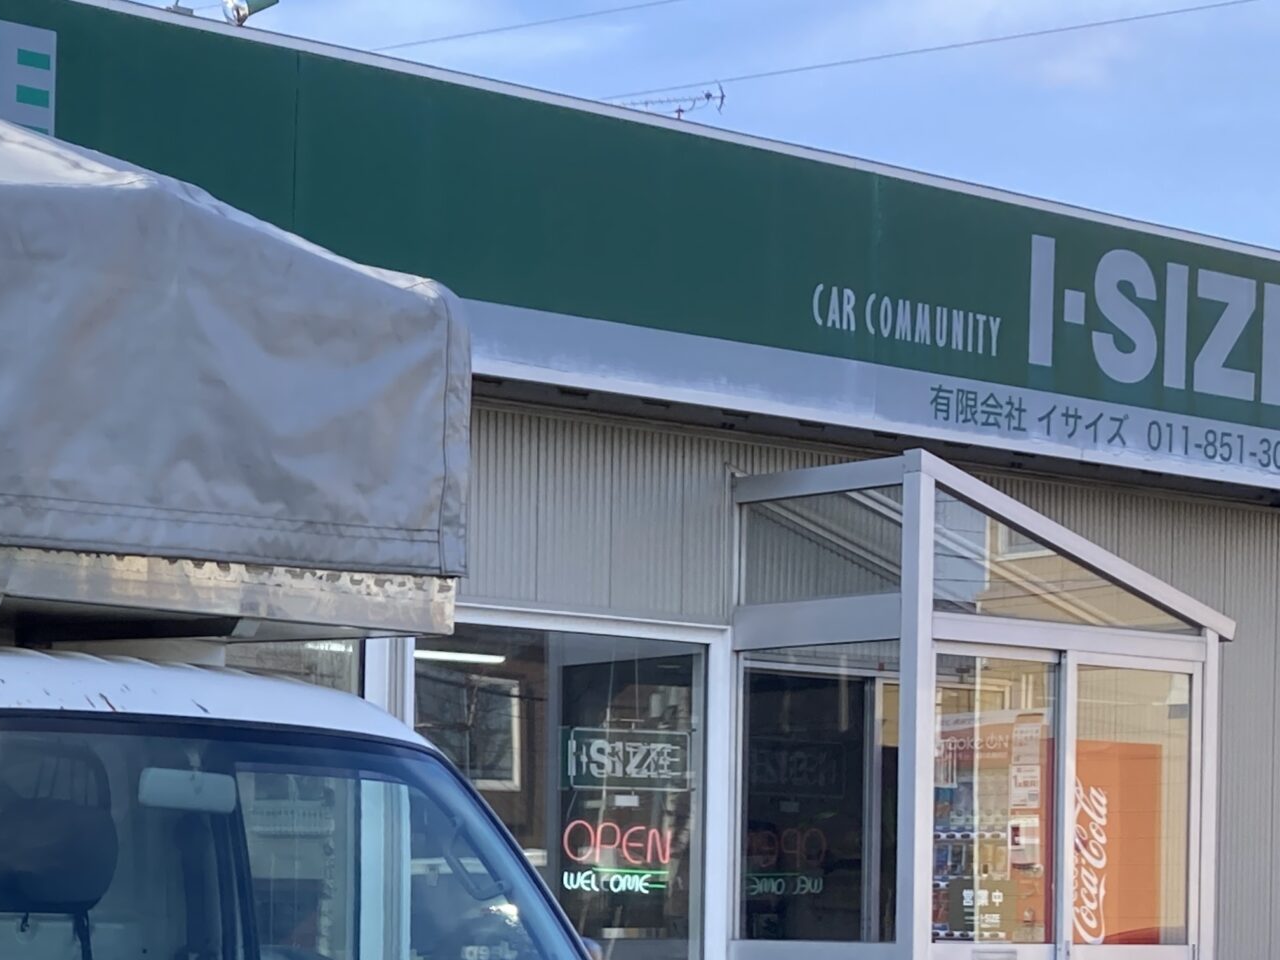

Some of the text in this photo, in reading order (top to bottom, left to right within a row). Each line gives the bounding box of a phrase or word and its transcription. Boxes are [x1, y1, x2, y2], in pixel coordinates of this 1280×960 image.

[813, 283, 1002, 357] CAR COMMUNITY
[930, 384, 1028, 433] 有限会社
[1037, 404, 1129, 447] イサイズ
[563, 819, 672, 865] OPEN
[562, 870, 653, 894] WELCOME
